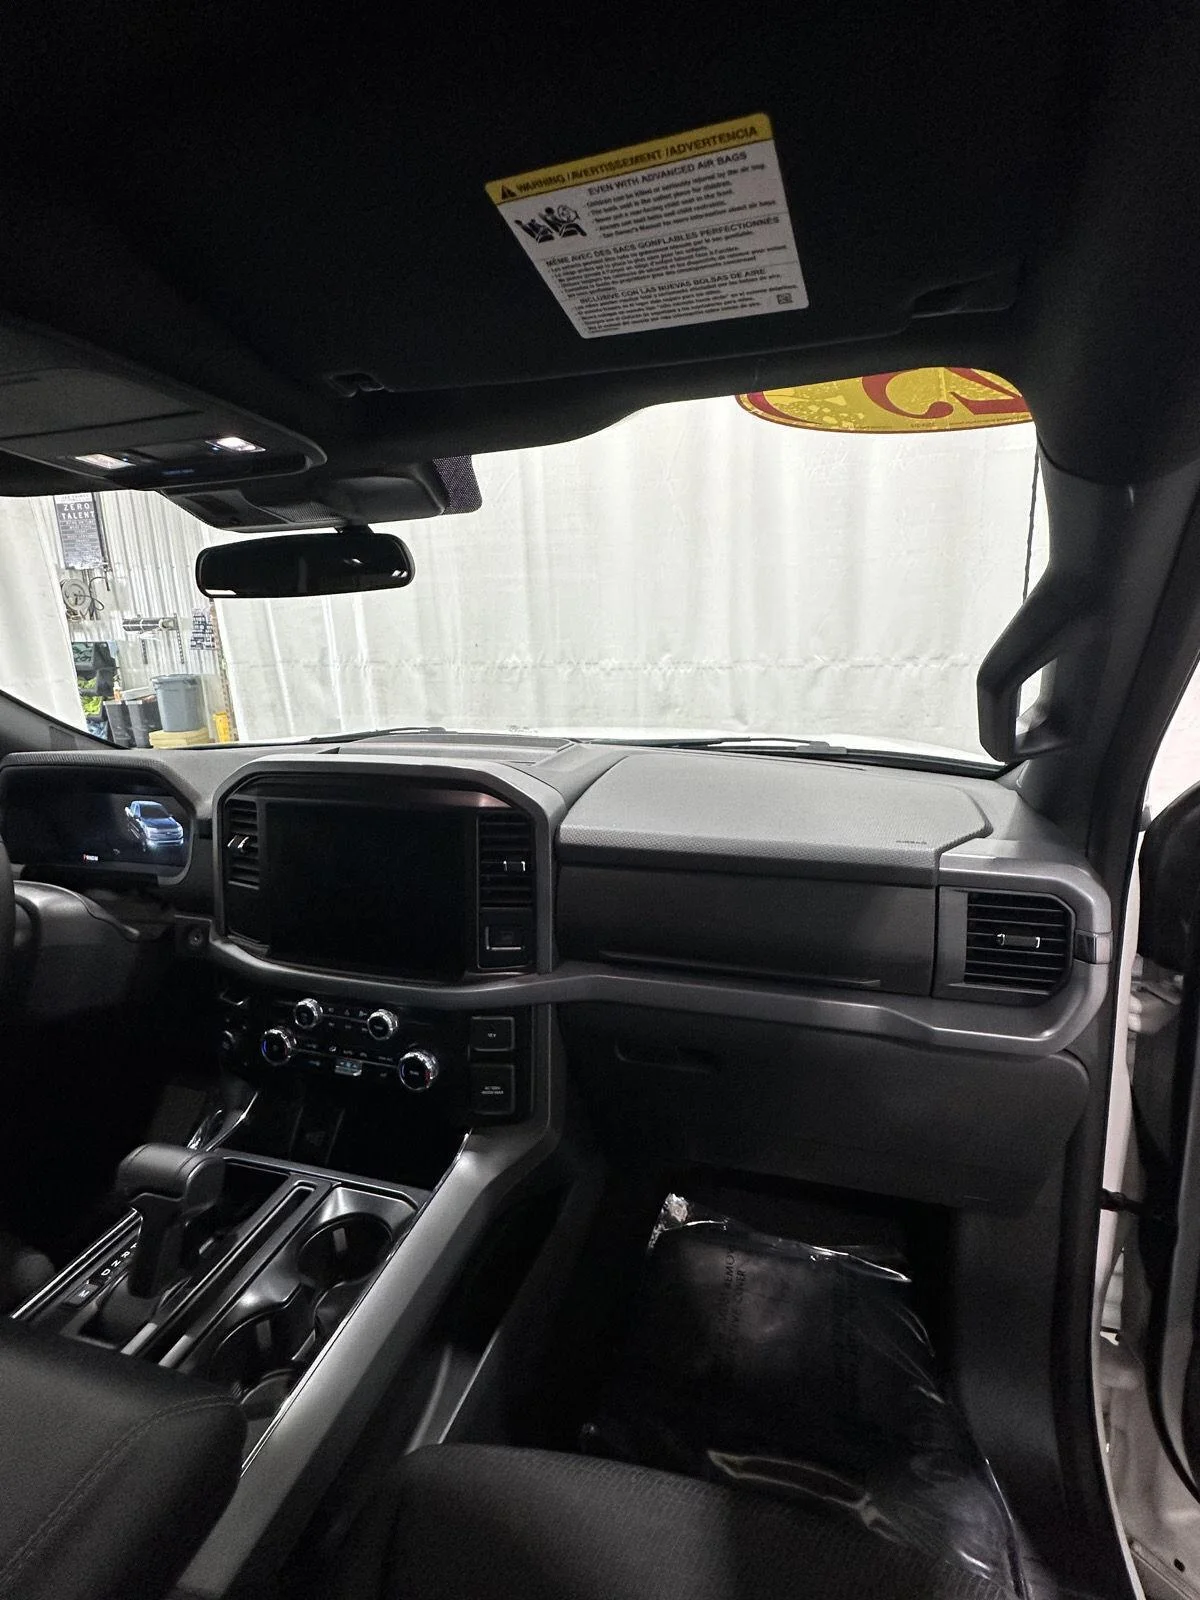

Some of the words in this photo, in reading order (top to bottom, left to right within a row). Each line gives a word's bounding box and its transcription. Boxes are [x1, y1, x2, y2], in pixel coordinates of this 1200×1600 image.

[588, 184, 613, 194] EVEN
[615, 178, 639, 188] WITH
[641, 165, 695, 183] ADVANCED
[698, 160, 713, 170] AIR
[717, 153, 747, 165] BAGS
[516, 175, 565, 191] WARNING
[570, 252, 594, 262] AVEC
[593, 248, 613, 257] DES
[612, 244, 637, 254] SACS
[637, 232, 698, 248] GONFLABLES
[657, 281, 692, 291] NUEVAS
[693, 275, 729, 284] BOLSAS
[62, 510, 95, 519] TALENT
[64, 502, 90, 511] ZERO
